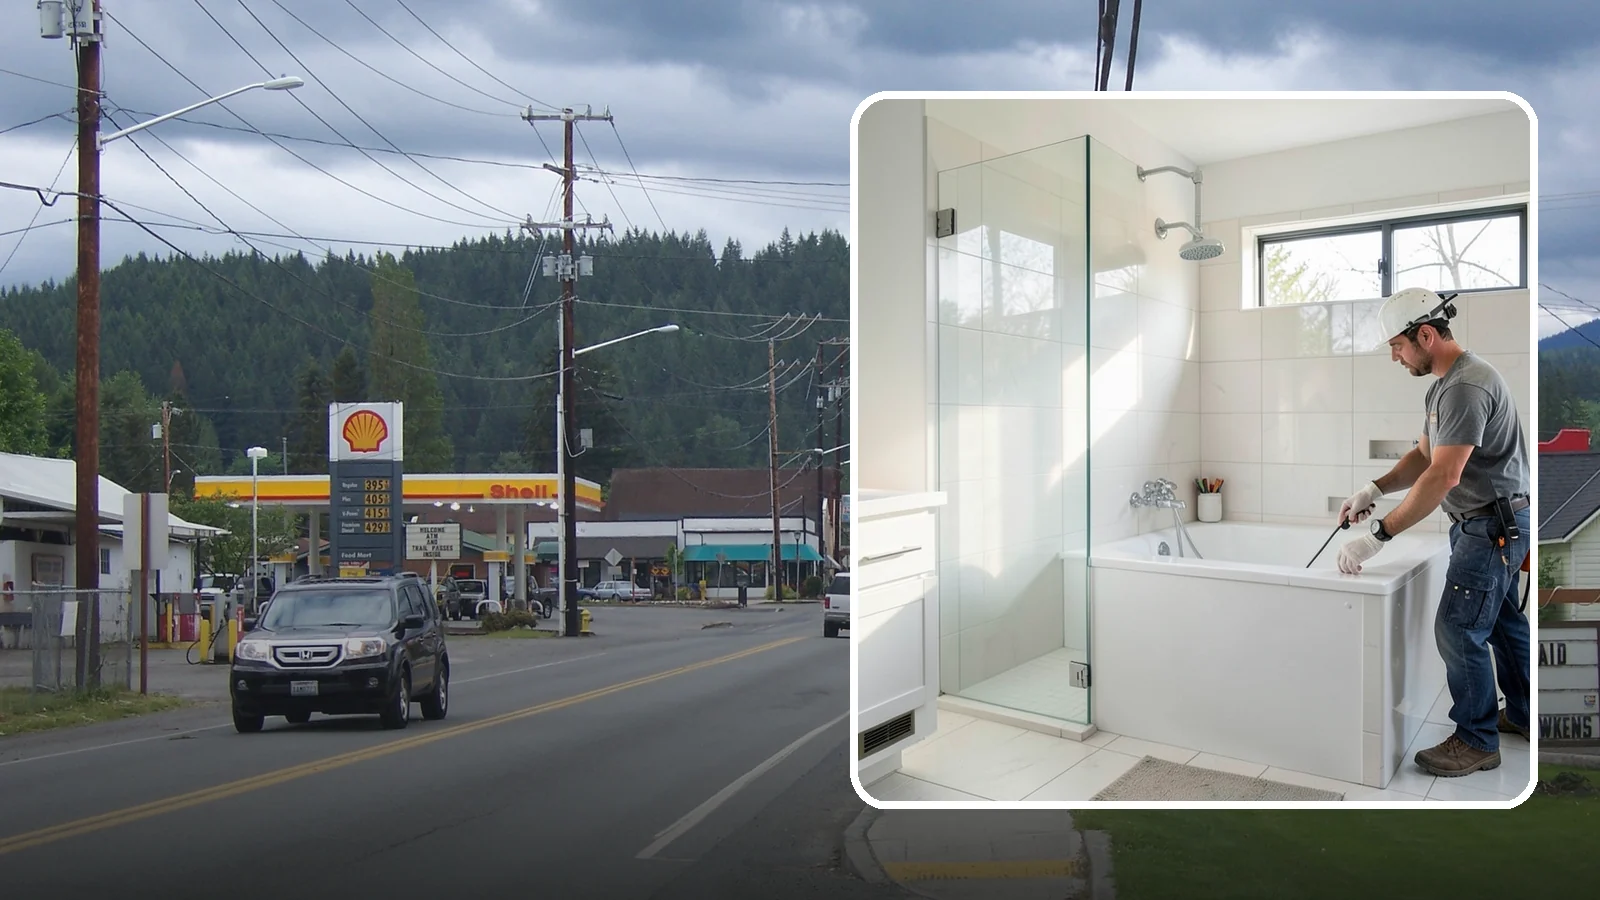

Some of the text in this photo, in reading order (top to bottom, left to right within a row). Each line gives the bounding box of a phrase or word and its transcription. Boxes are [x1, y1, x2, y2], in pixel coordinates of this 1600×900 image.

[366, 480, 383, 490] 395
[490, 484, 547, 499] Shell
[366, 494, 383, 504] 405
[366, 508, 383, 518] 415
[366, 523, 383, 532] 429
[1538, 643, 1567, 666] AID
